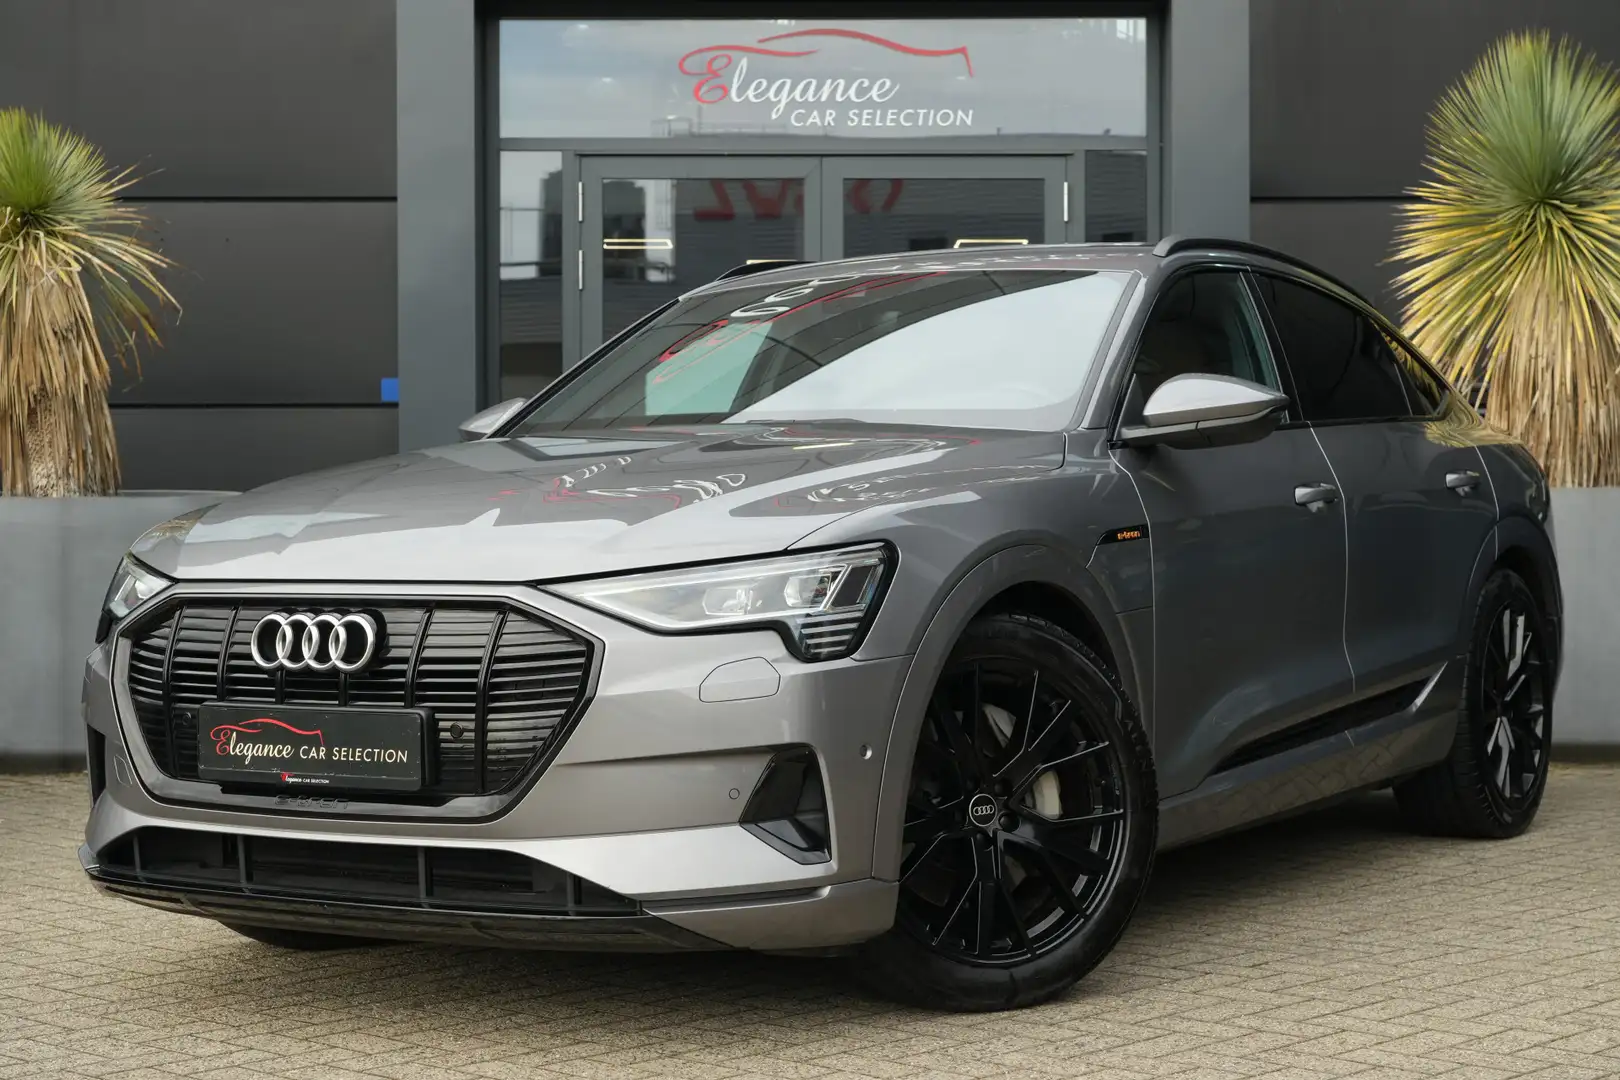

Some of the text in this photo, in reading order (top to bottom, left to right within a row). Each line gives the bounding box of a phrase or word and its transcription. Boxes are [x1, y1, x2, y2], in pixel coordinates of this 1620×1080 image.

[679, 46, 900, 120] Elegance
[790, 109, 974, 127] CAR SELECTION
[210, 727, 408, 765] Elegance CAR SELECTION
